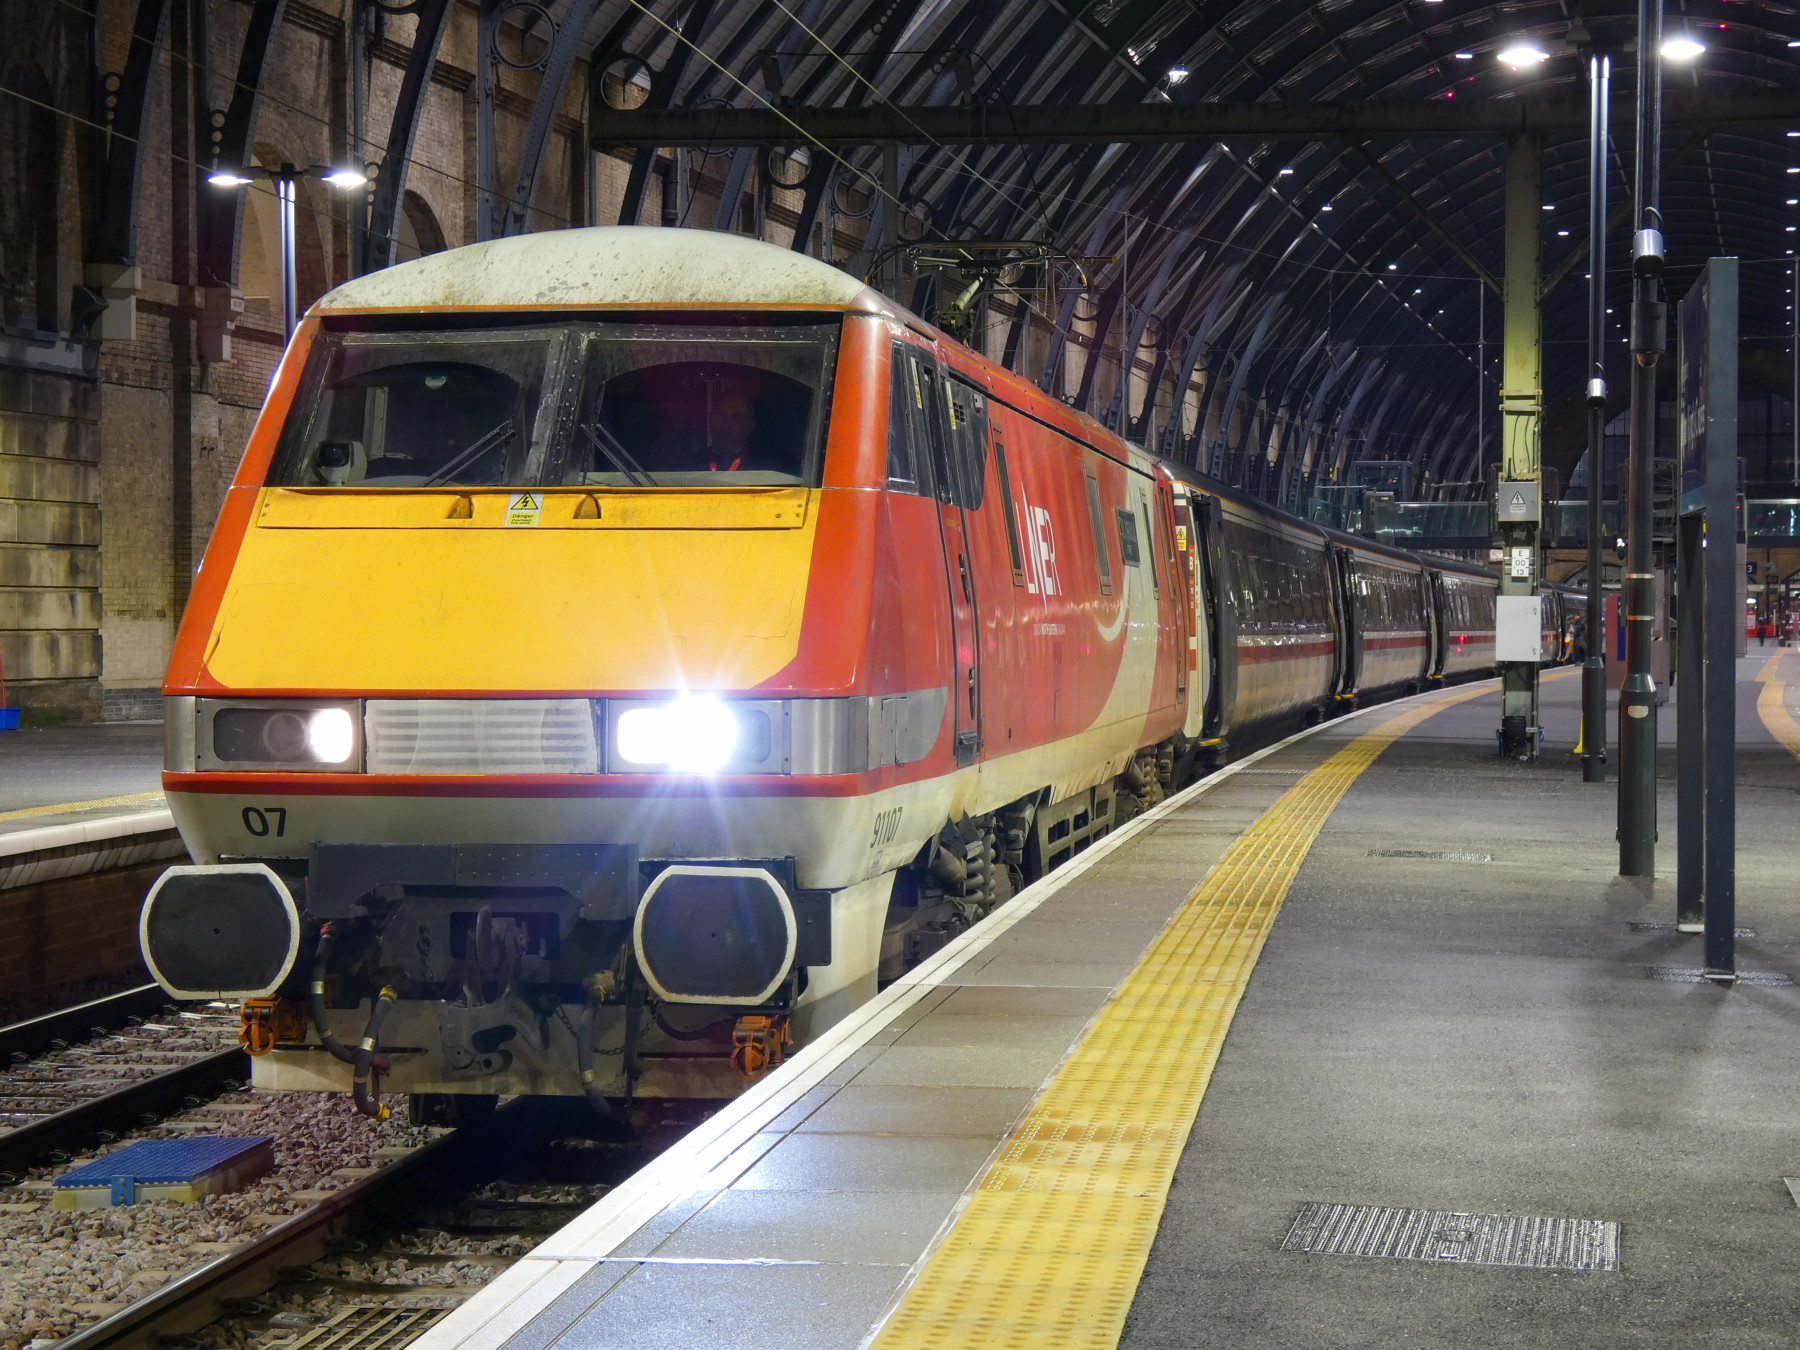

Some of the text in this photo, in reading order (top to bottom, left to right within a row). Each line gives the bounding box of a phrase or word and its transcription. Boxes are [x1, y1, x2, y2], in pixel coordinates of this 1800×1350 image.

[1015, 480, 1062, 613] LNER
[242, 806, 286, 837] 07
[870, 806, 903, 848] 91107
